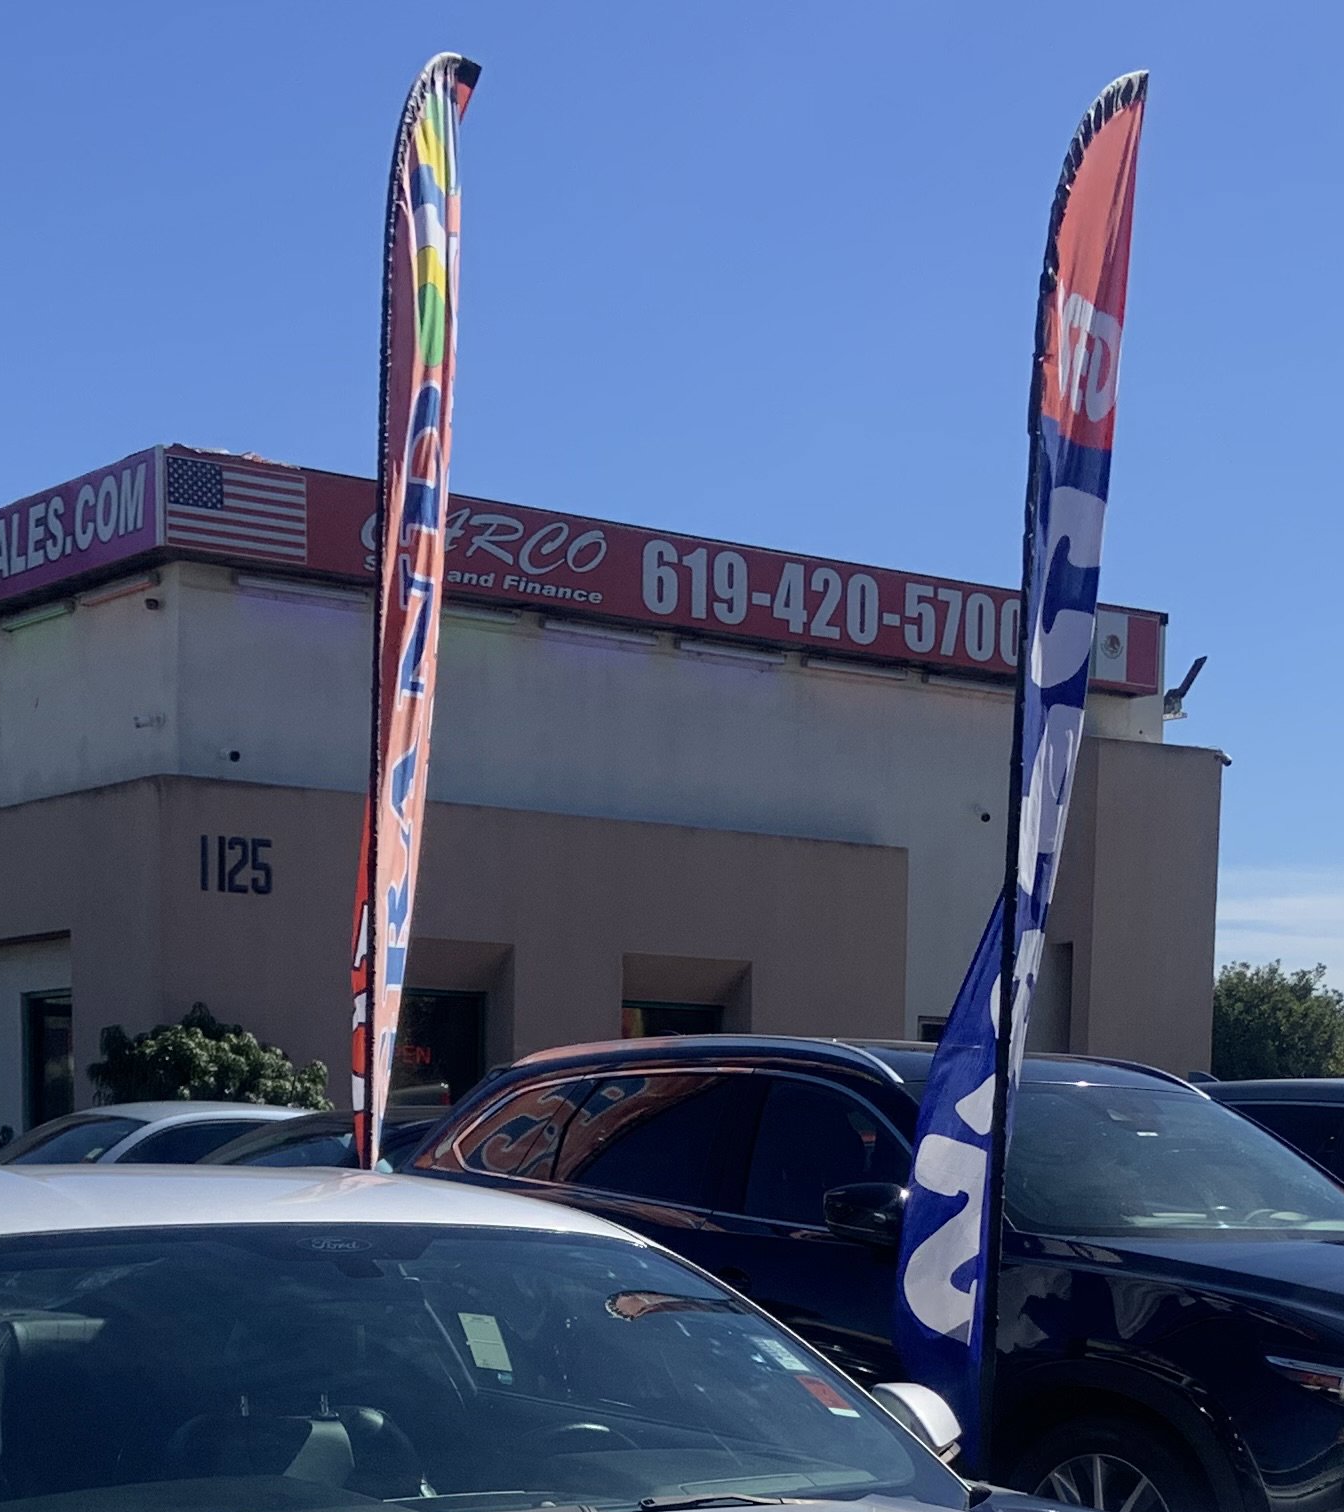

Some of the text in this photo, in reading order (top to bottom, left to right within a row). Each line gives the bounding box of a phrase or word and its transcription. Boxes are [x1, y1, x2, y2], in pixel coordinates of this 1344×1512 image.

[447, 569, 604, 604] and Finance
[200, 834, 273, 895] 1125
[312, 1238, 360, 1249] Ford
